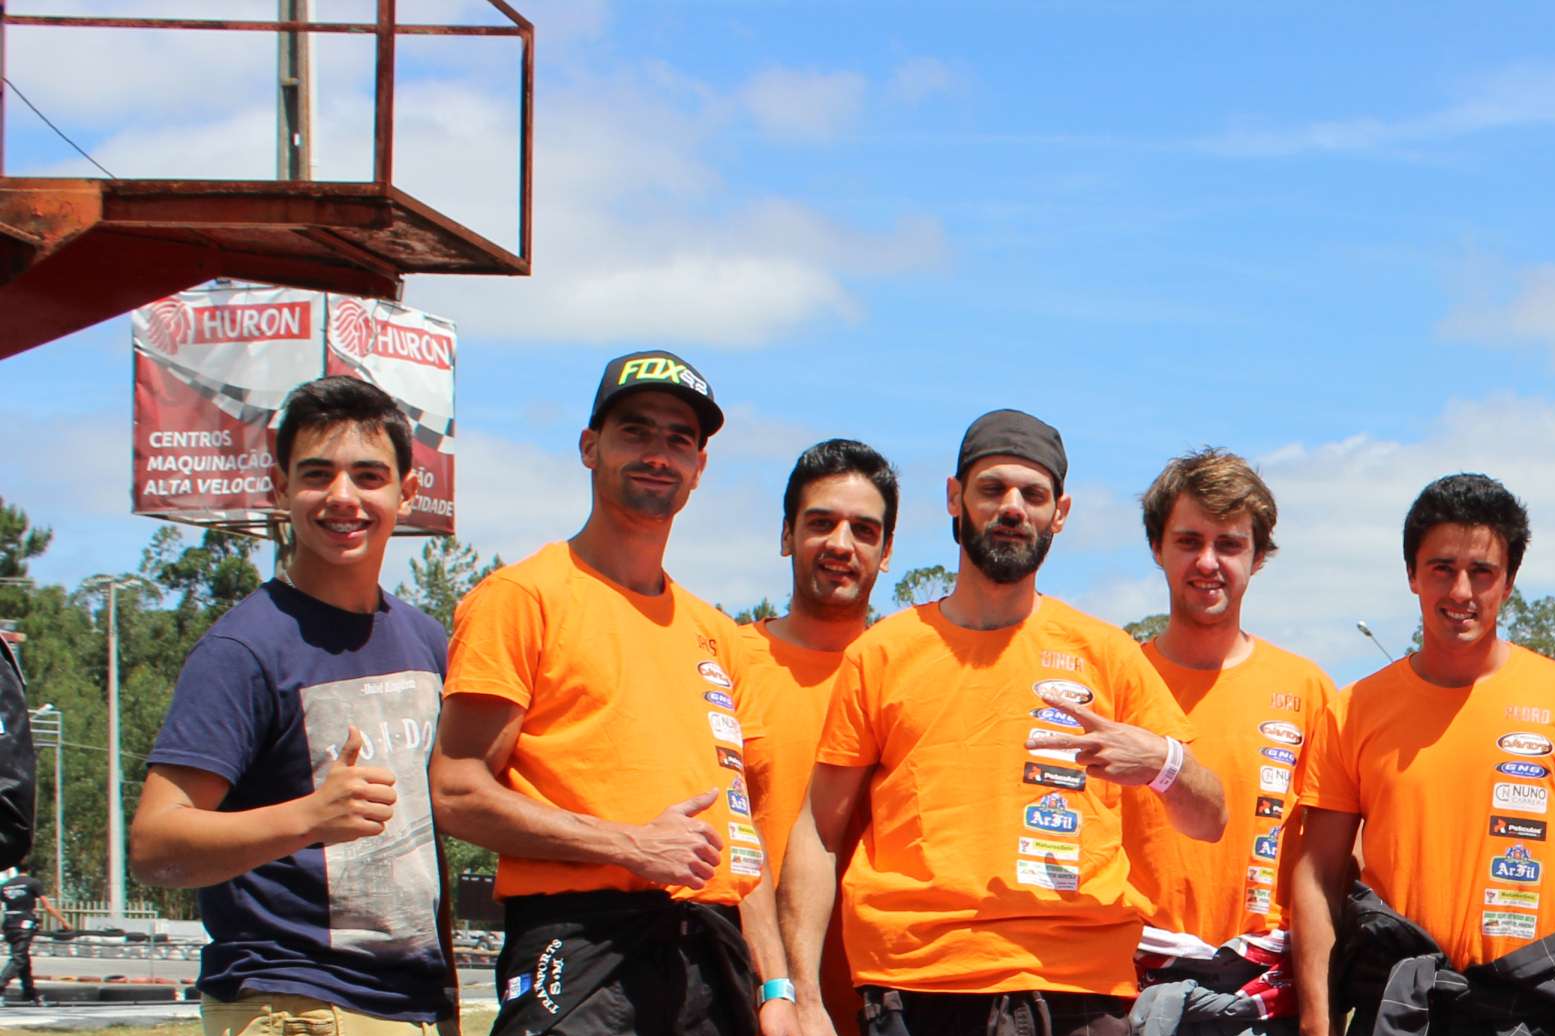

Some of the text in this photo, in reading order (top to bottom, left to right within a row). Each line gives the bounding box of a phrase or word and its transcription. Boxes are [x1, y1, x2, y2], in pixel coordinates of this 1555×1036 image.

[202, 306, 300, 339] HURON
[376, 326, 450, 367] HURON
[617, 357, 688, 386] FOX
[149, 430, 232, 449] CENTROS
[145, 450, 274, 473] MAQUINAÇÃO
[143, 475, 274, 496] ALTA VELOCID
[409, 495, 454, 515] CIDADE
[1512, 785, 1546, 800] NUNO
